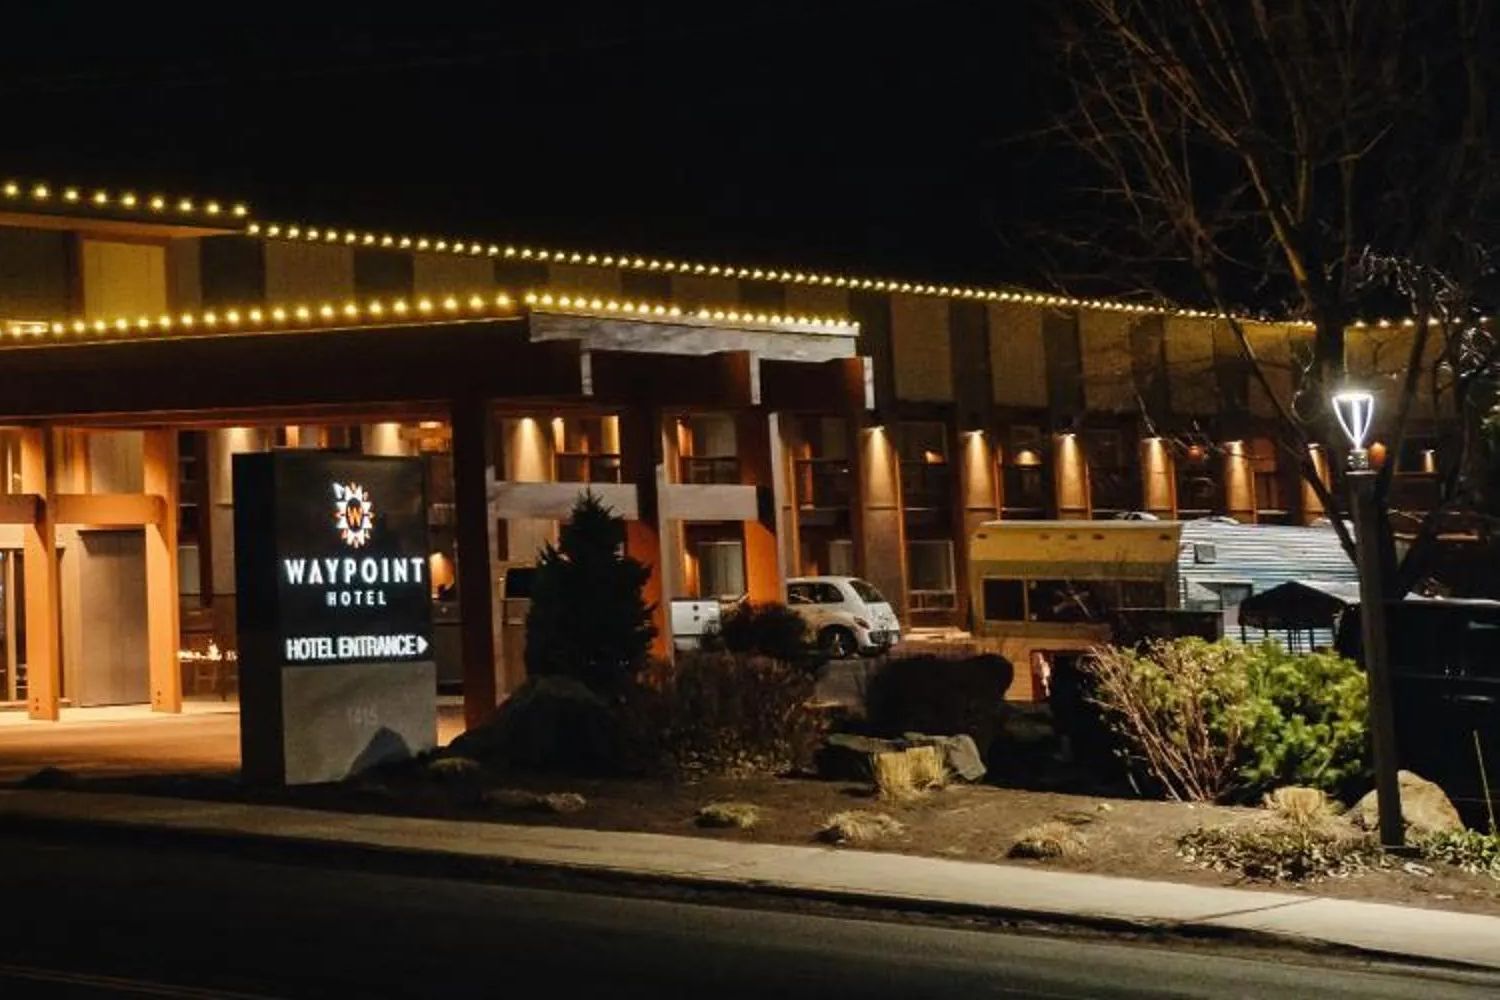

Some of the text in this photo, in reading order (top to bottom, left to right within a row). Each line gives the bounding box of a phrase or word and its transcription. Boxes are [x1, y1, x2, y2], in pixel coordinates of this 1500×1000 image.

[348, 506, 363, 527] W
[284, 557, 425, 584] WAYPOINT
[326, 590, 387, 606] HOTEL
[285, 634, 417, 660] HOTEL ENTRANCE
